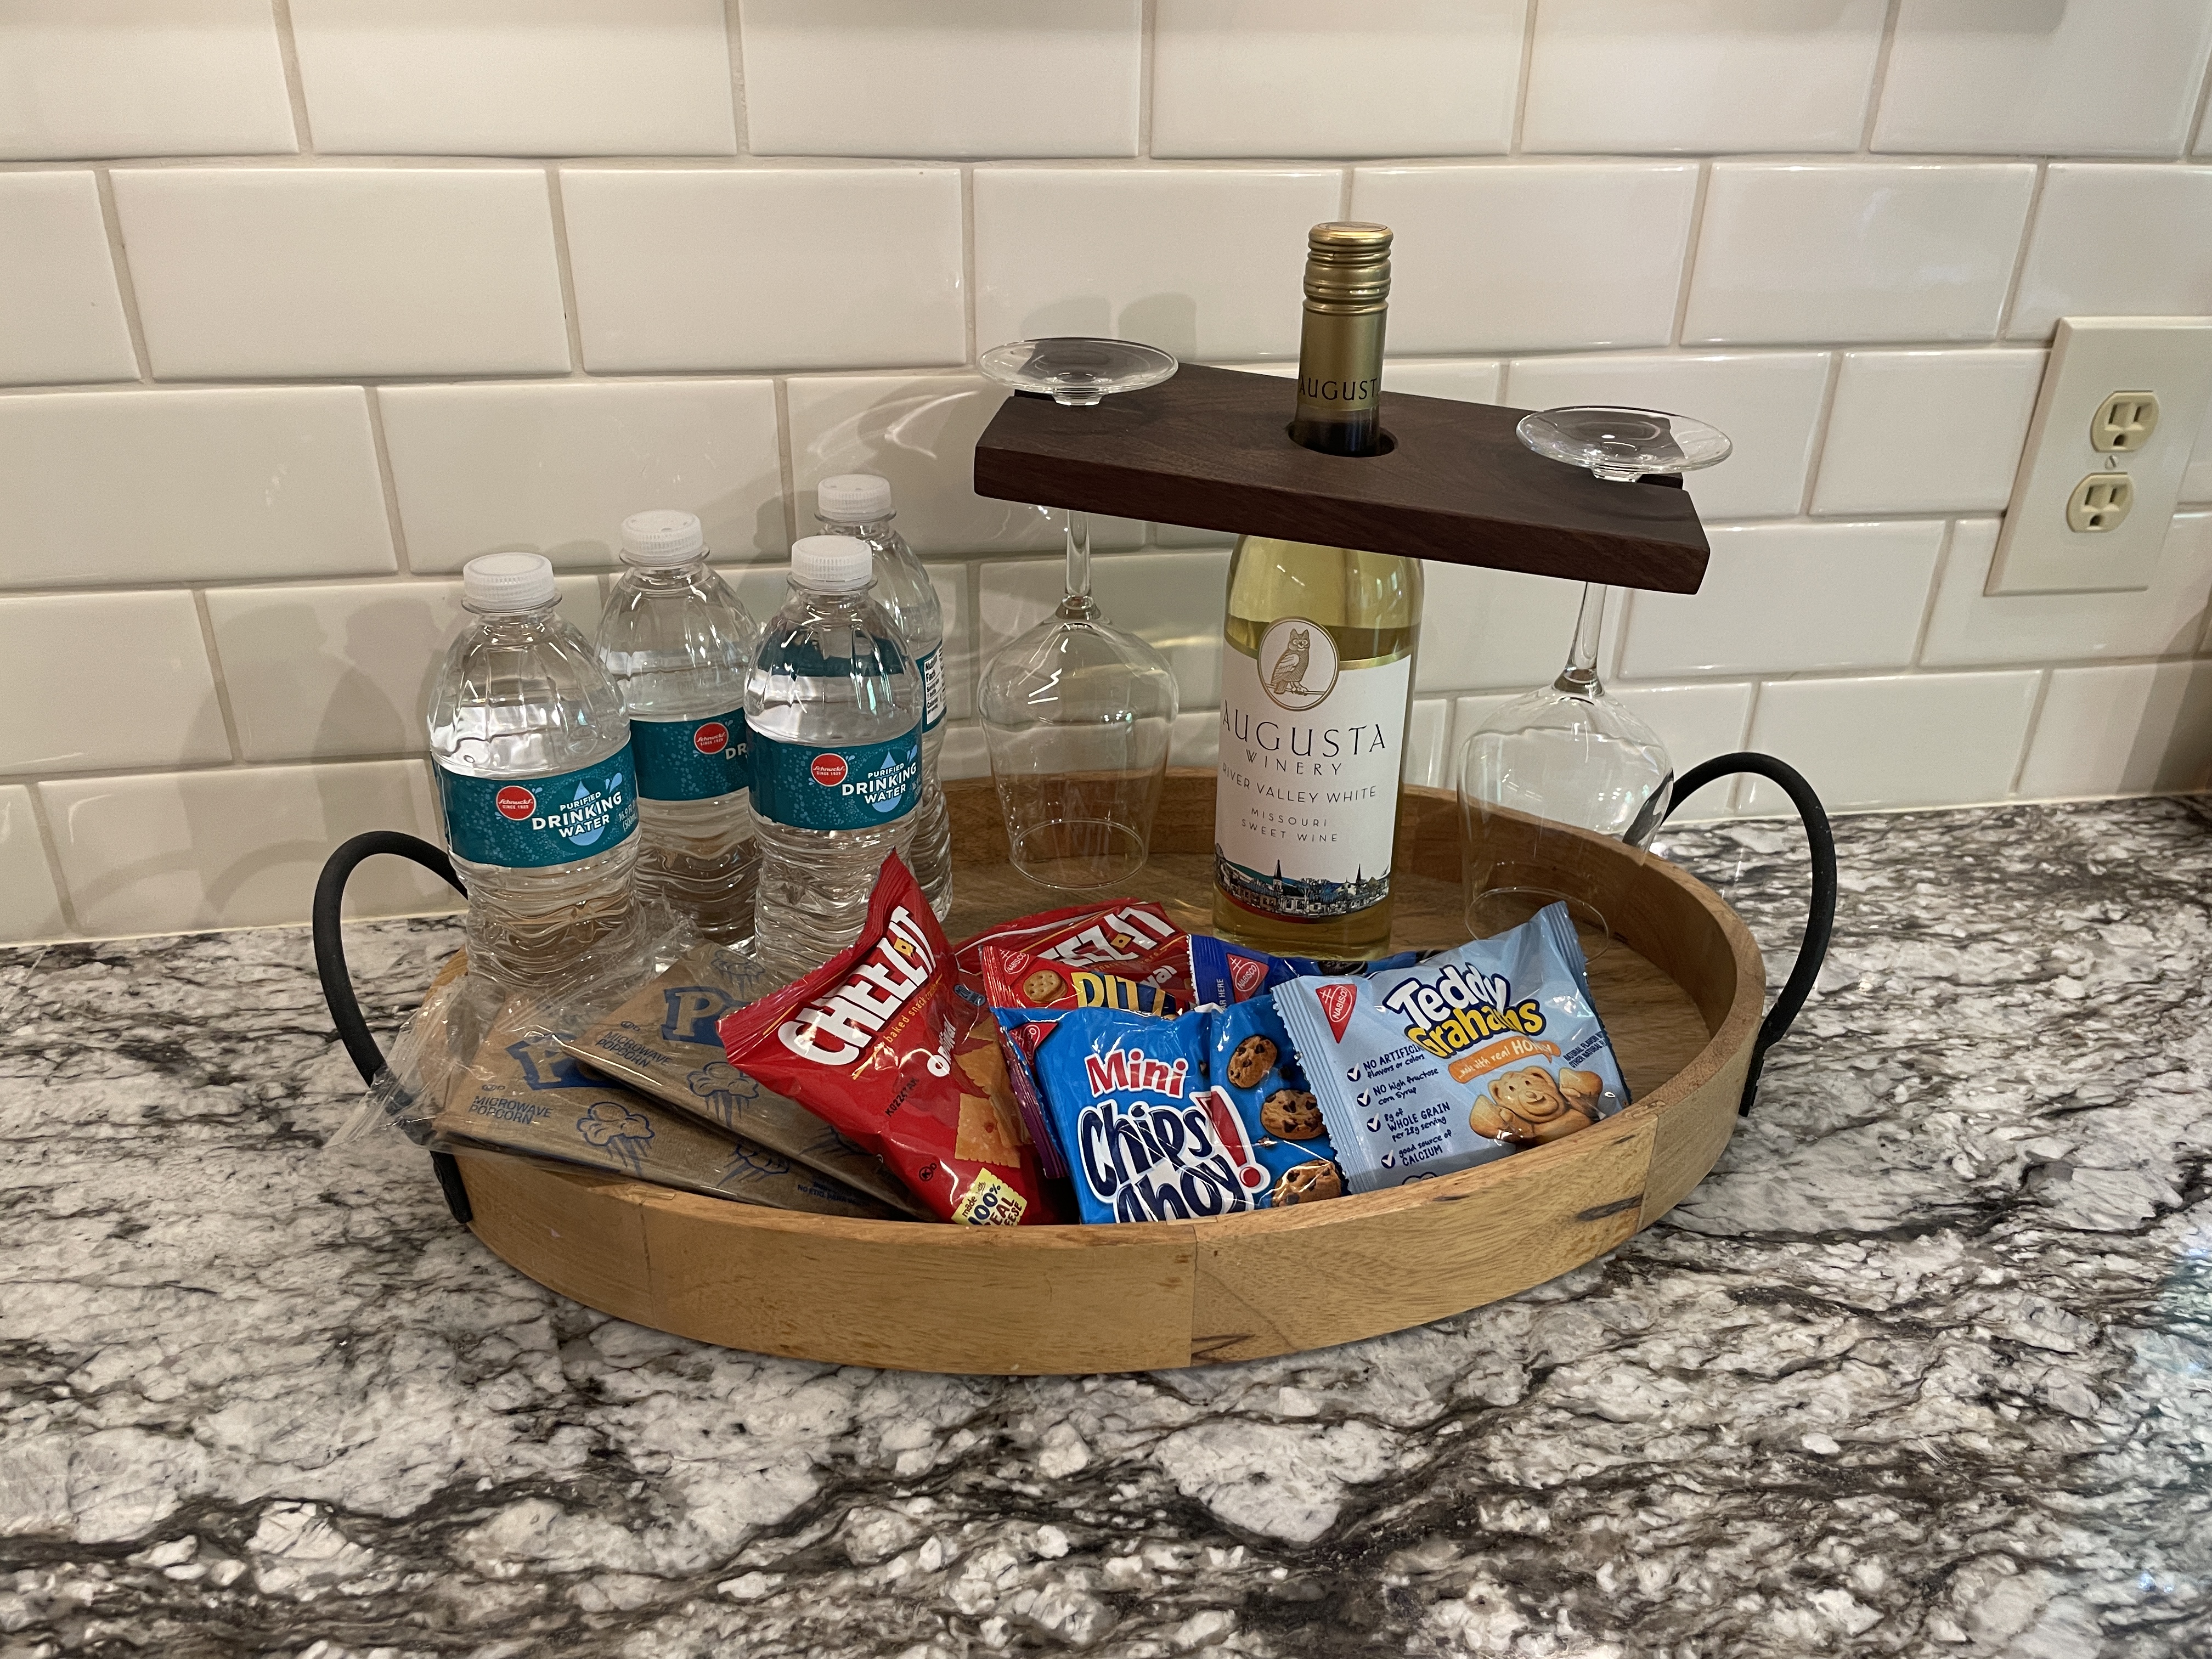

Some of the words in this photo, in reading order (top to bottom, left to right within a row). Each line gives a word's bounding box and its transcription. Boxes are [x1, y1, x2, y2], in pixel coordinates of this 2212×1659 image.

[1299, 374, 1378, 400] AUGUST
[1222, 699, 1385, 758] AUGUSTA
[868, 763, 904, 778] PURIFIED
[1245, 749, 1342, 776] WINERY
[842, 762, 916, 796] DRINKING
[1223, 762, 1250, 790] RIVER
[1256, 782, 1318, 803] VALLEY
[1327, 785, 1377, 803] WHITE
[560, 792, 601, 811] PURIFIED
[864, 784, 906, 804] WATER
[532, 791, 622, 830] DRINKING
[1251, 808, 1327, 827] MISSOURI
[558, 814, 610, 838] WATER
[1242, 819, 1286, 839] SWEET
[1297, 833, 1338, 842] WINE
[1006, 952, 1026, 973] NABISCO
[1216, 978, 1226, 998] HERE
[1237, 964, 1257, 989] NABISCO
[1332, 988, 1348, 1019] NABISCO
[1385, 964, 1509, 1030] Teddy
[883, 1014, 910, 1043] baked
[909, 997, 928, 1016] snack
[595, 1039, 651, 1068] POPCORN
[603, 1031, 673, 1065] MICROWAVE
[1363, 1059, 1377, 1071] NO
[1379, 1044, 1424, 1065] ARTIFICIA
[1490, 1045, 1511, 1062] real
[1086, 1049, 1188, 1097] Mini
[1367, 1064, 1394, 1079] flavors
[1404, 1053, 1425, 1065] colors
[1373, 1084, 1387, 1096] NO
[1388, 1079, 1406, 1091] high
[1406, 1068, 1439, 1084] fructose
[473, 1096, 552, 1118] MICROWAVE
[1378, 1095, 1395, 1105] corn
[468, 1104, 534, 1125] POPCORN
[1384, 1114, 1394, 1122] 8g
[1395, 1108, 1403, 1117] of
[1387, 1113, 1419, 1132] WHOLE
[1420, 1101, 1451, 1120] GRAIN
[1392, 1132, 1404, 1142] per
[1404, 1126, 1420, 1136] 28g
[1420, 1116, 1447, 1131] serving
[1080, 1103, 1213, 1198] Chips
[1399, 1144, 1417, 1158] good
[1418, 1135, 1443, 1149] source
[1444, 1128, 1452, 1138] of
[1402, 1144, 1443, 1166] CALCIUM
[962, 1196, 978, 1218] made
[1003, 1201, 1023, 1226] EESE
